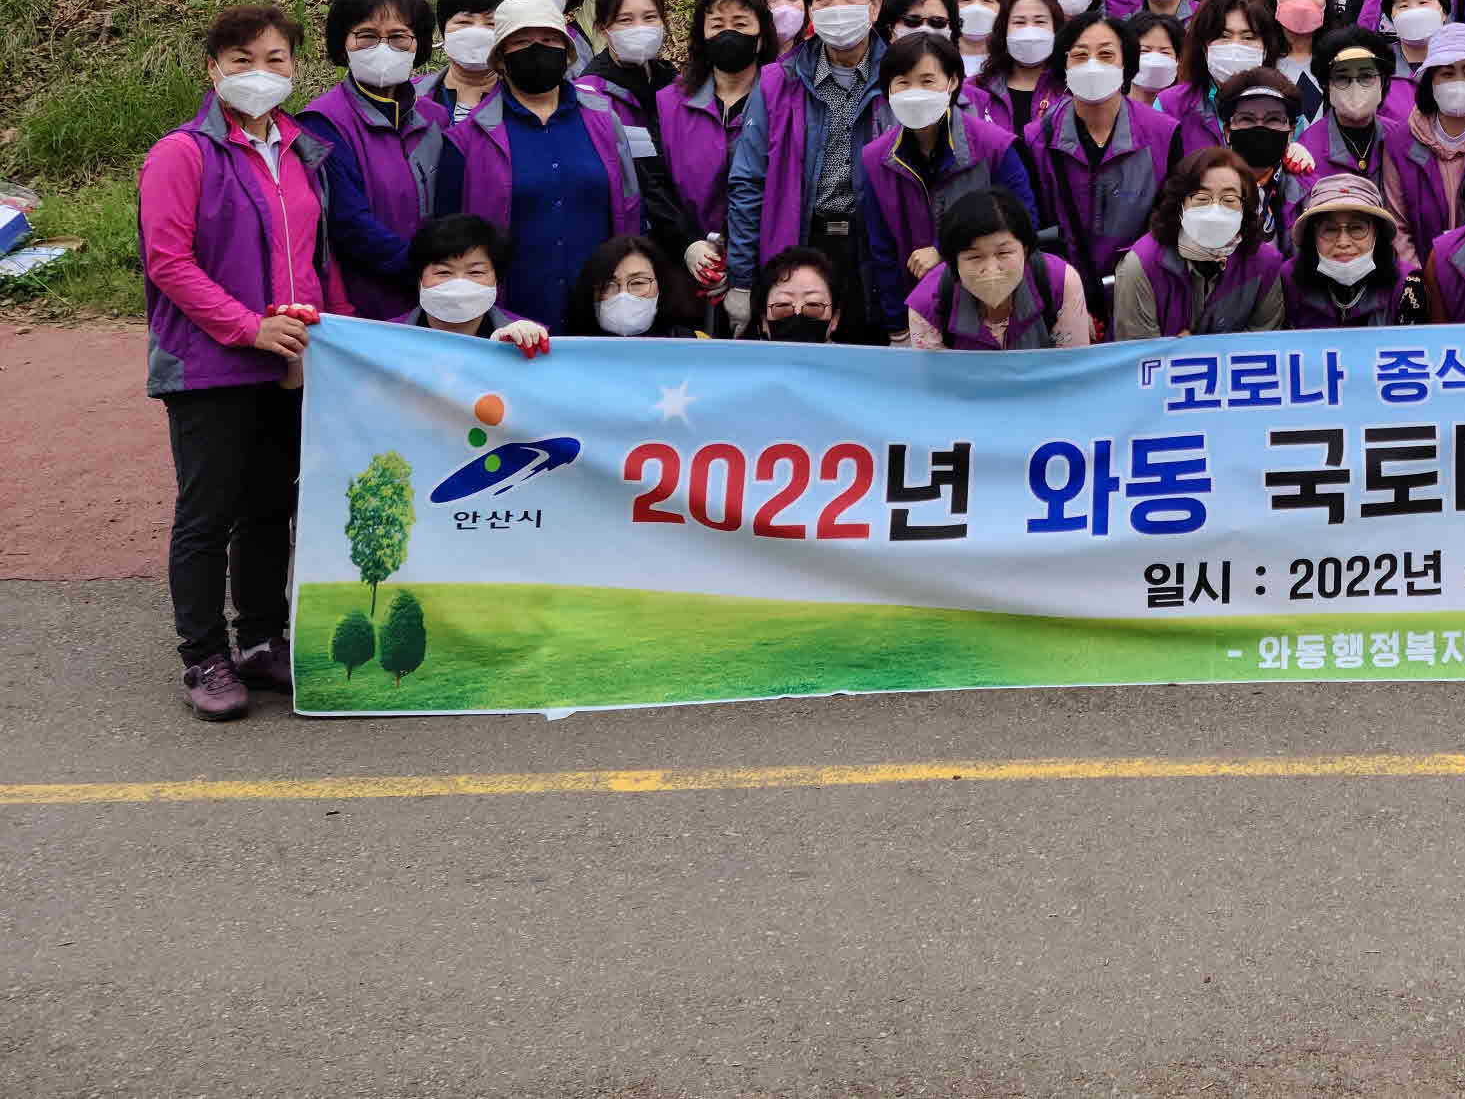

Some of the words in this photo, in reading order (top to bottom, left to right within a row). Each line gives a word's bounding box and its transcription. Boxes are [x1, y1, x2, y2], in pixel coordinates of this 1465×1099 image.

[623, 441, 971, 542] 2022년
[1026, 433, 1212, 538] 와동
[453, 508, 544, 531] 안산시
[1143, 560, 1233, 608] 일시
[1288, 549, 1444, 601] 2022년
